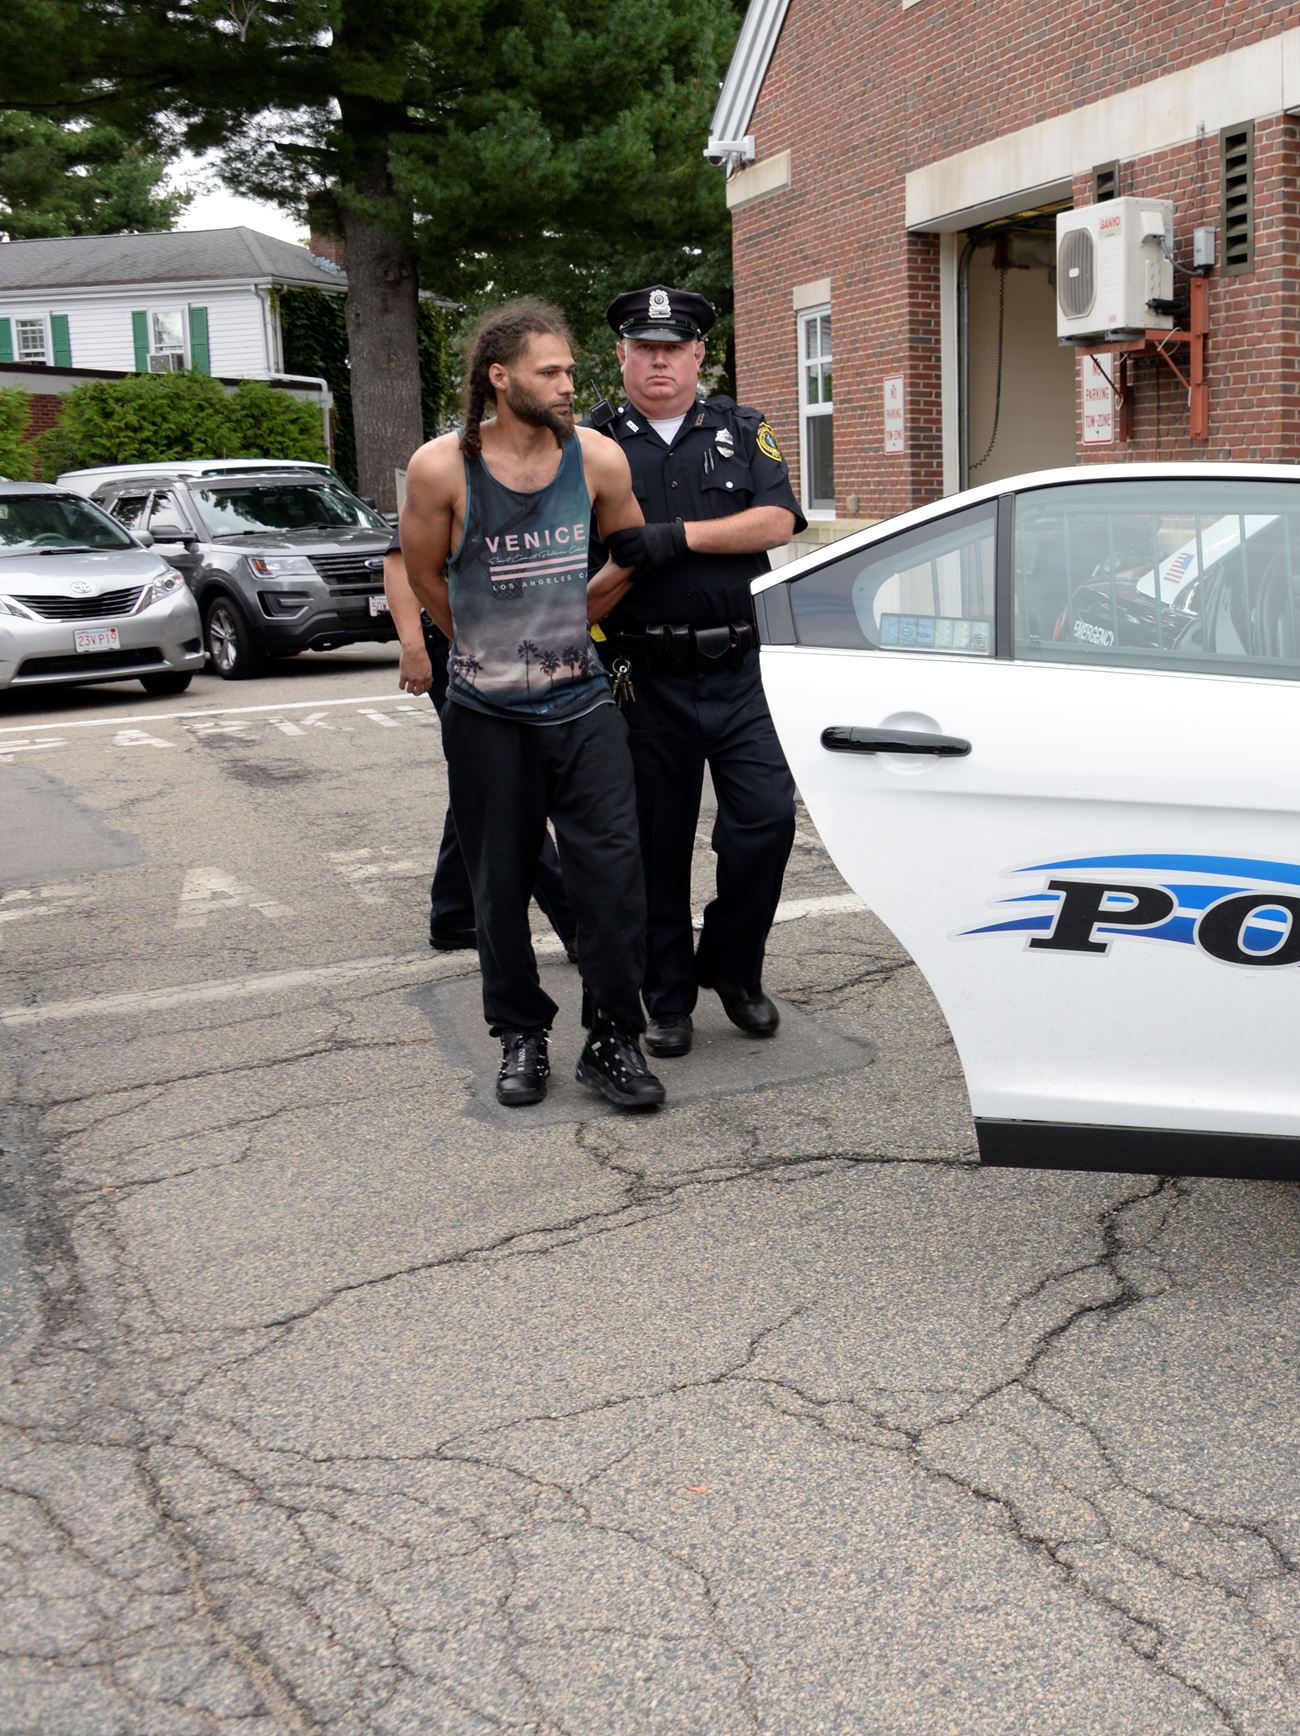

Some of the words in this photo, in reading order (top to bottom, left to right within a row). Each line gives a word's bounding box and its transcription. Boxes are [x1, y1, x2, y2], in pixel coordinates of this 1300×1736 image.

[1100, 216, 1121, 230] SANYO
[1086, 387, 1110, 402] PARKING
[484, 523, 586, 554] VENICE
[493, 583, 515, 592] LOS
[522, 574, 573, 588] ANGELES
